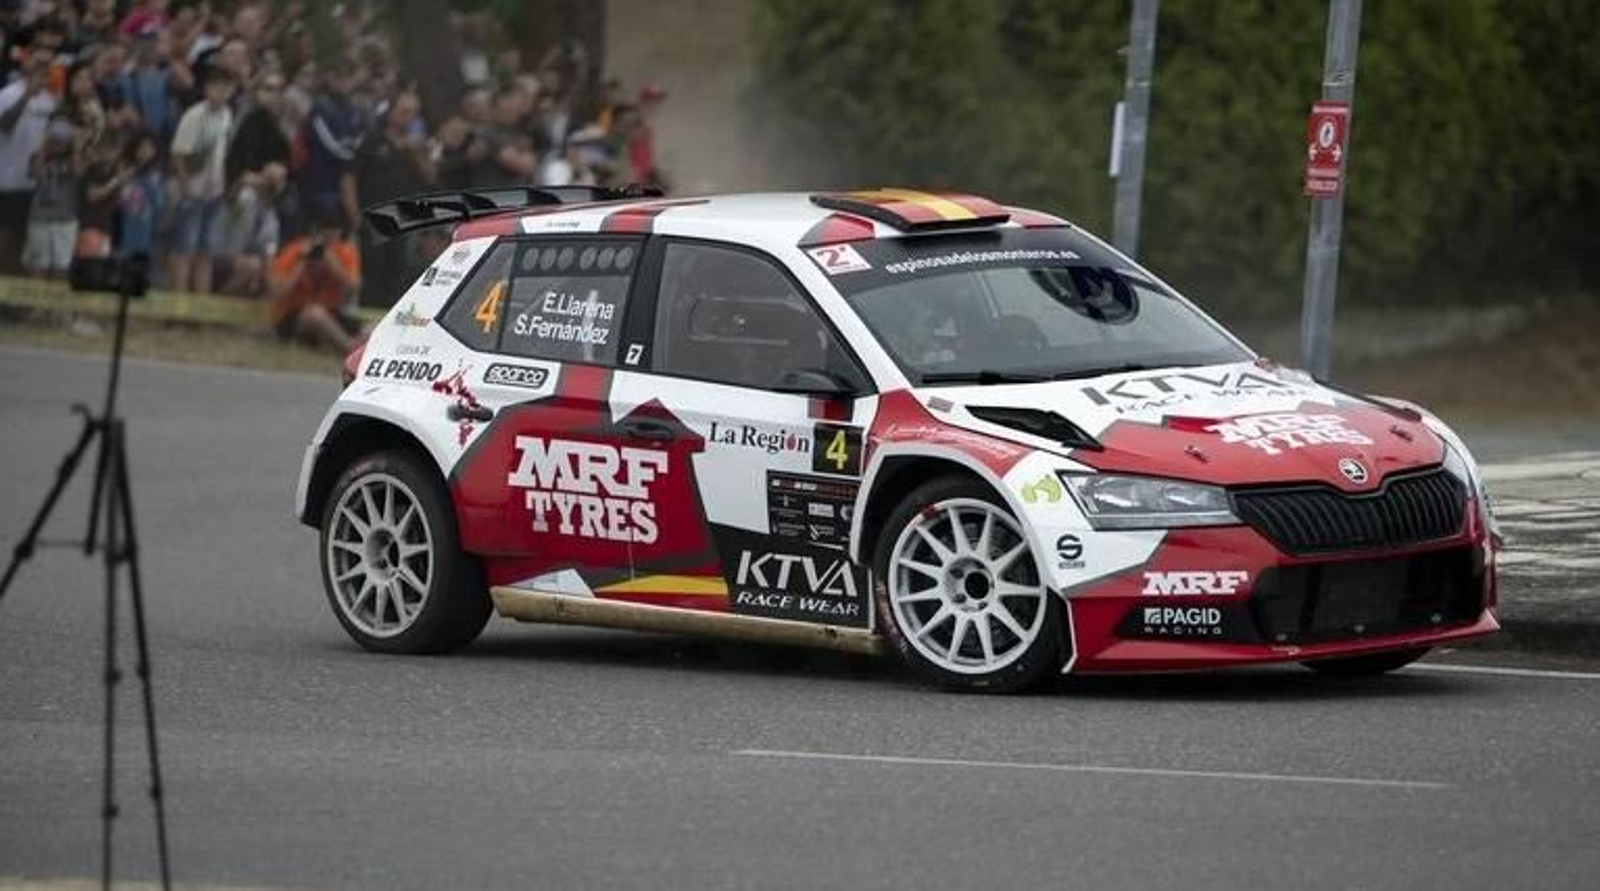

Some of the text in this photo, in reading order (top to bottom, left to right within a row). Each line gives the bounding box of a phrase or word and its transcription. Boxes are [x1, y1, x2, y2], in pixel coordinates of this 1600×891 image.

[474, 279, 507, 334] 4
[543, 292, 615, 320] E.Llarena
[514, 313, 609, 345] S.Fernández
[365, 359, 442, 382] EL PENDO
[487, 364, 545, 385] sparco
[1080, 373, 1288, 405] KTVA
[710, 422, 736, 444] La
[1202, 414, 1347, 443] MRF
[1242, 429, 1374, 455] TYRES
[826, 430, 848, 470] 4
[507, 435, 668, 500] MRF
[525, 490, 658, 544] TYRES
[736, 551, 858, 597] KTVA
[1142, 570, 1248, 596] MRF
[737, 591, 860, 616] RACE WEAR
[1163, 608, 1221, 624] PAGID
